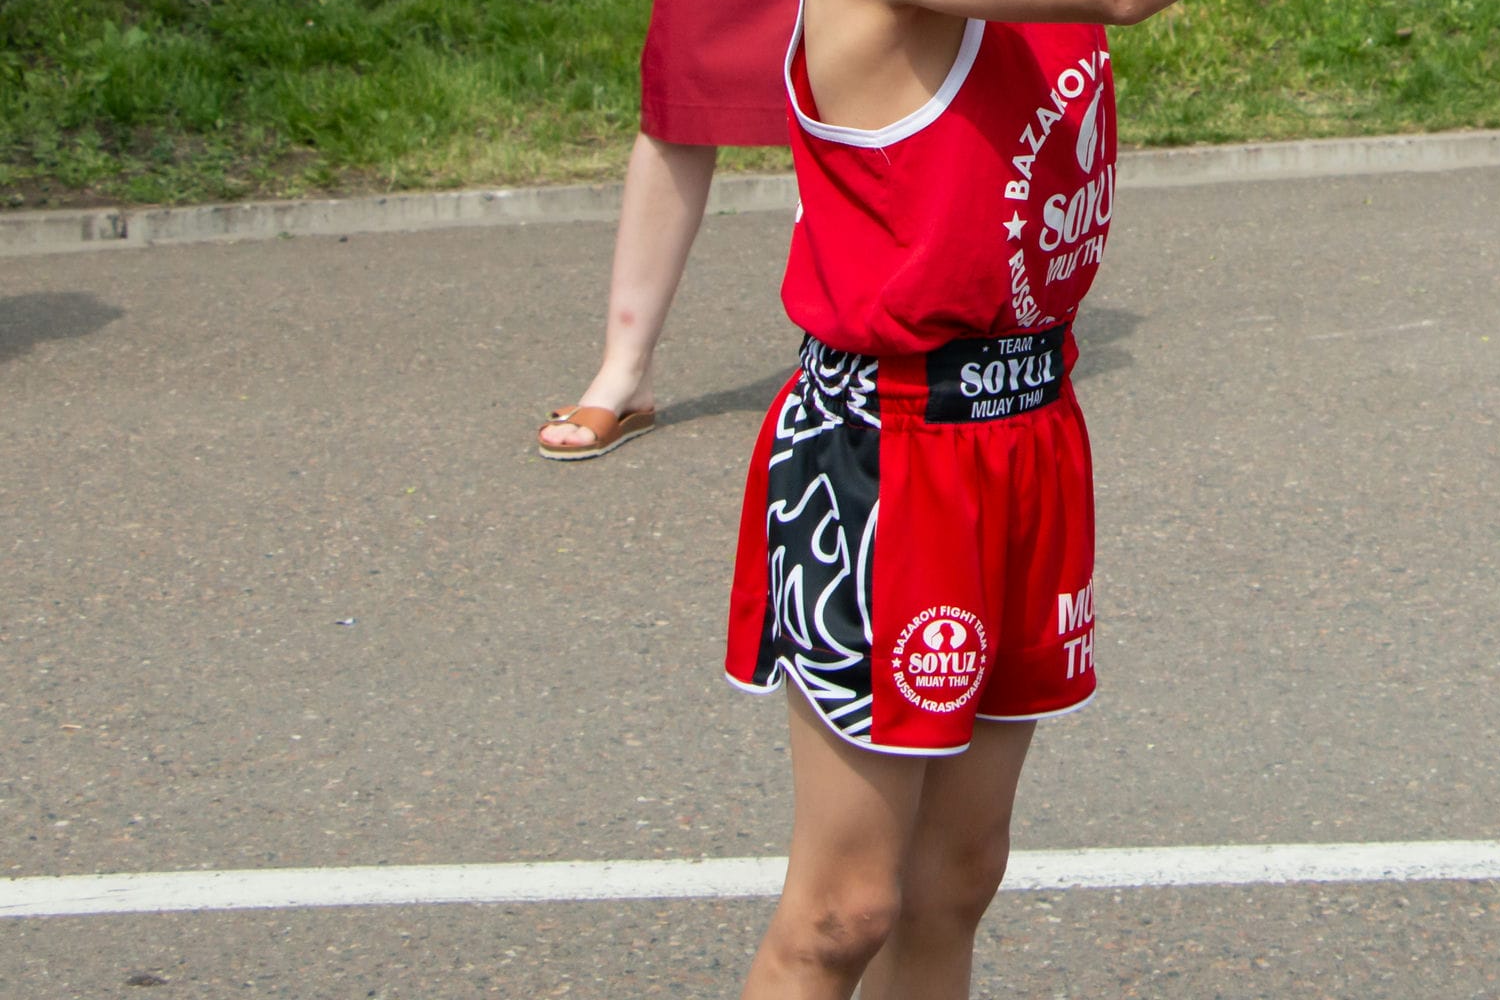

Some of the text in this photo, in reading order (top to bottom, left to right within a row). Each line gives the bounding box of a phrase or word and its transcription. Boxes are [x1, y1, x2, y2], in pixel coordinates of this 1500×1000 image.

[1039, 164, 1112, 252] SOYU
[998, 336, 1032, 355] TEAM
[971, 388, 1044, 419] MUAY THAI
[893, 605, 987, 655] BAZAROV FIGHT TEAM
[908, 651, 977, 674] SOYUZ
[893, 671, 921, 706] RUSSIA
[916, 675, 969, 687] MUAY THAI
